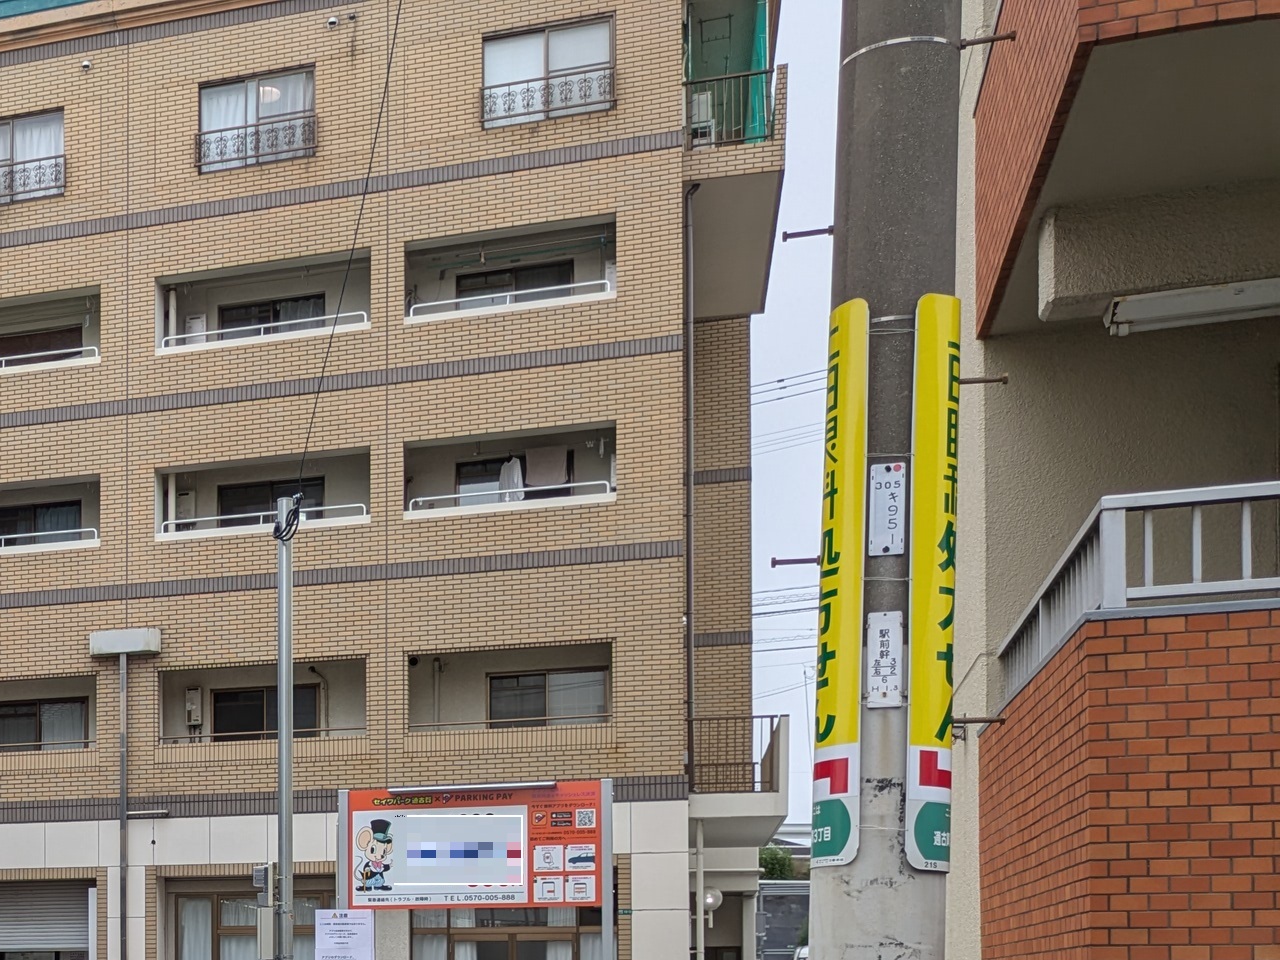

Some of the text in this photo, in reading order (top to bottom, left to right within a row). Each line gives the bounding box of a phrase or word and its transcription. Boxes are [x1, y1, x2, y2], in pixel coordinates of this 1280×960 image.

[875, 480, 901, 490] 305
[878, 628, 891, 660] 駅前幹
[873, 657, 897, 667] 左 3
[889, 666, 897, 675] 2
[881, 675, 888, 684] 6
[455, 793, 495, 802] PARKING
[496, 792, 514, 801] PAY
